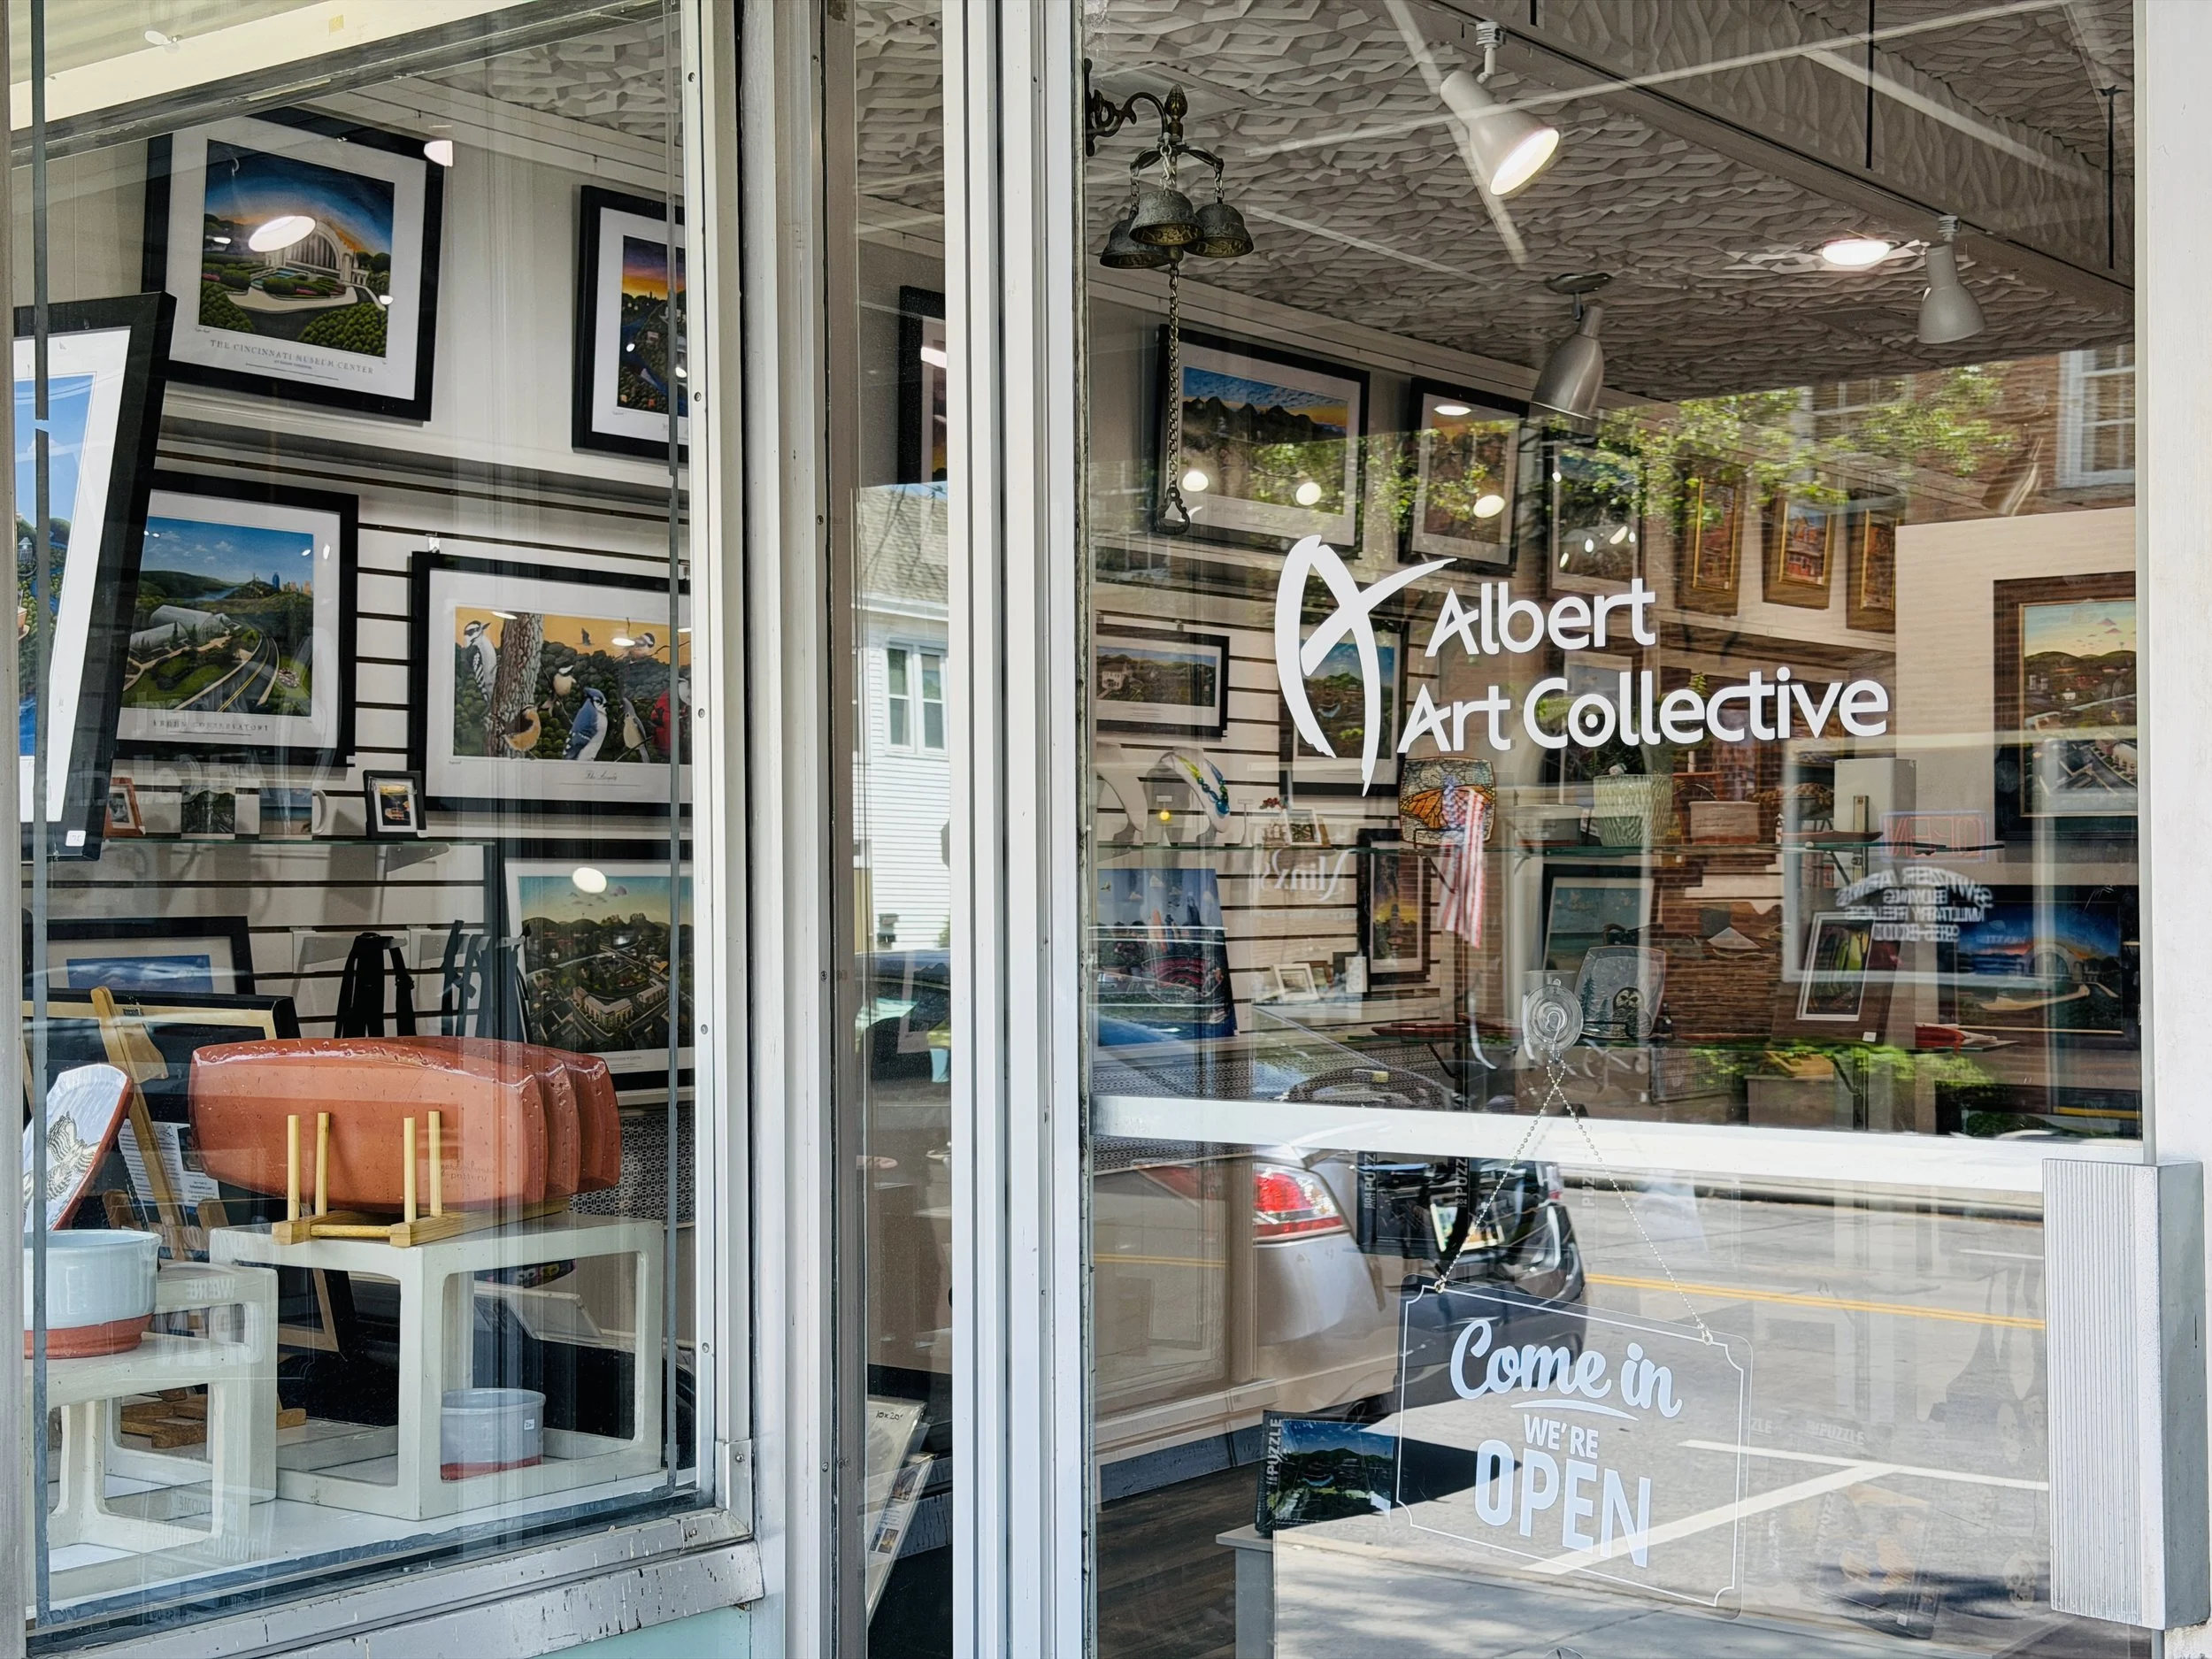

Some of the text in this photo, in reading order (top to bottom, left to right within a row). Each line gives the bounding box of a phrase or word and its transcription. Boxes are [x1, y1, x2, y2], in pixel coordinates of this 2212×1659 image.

[210, 339, 230, 349] THE
[234, 343, 293, 361] CINCINNATI
[296, 354, 334, 368] MUSEUM
[337, 361, 374, 375] CENTER
[1425, 578, 1656, 657] Albert
[1397, 667, 1888, 754] Art Collective
[1364, 1153, 1377, 1191] PUZ
[1450, 1319, 1683, 1417] Come in
[1266, 1418, 1282, 1475] PUZZLE
[1524, 1414, 1599, 1459] WE'RE
[1475, 1439, 1651, 1569] OPEN
